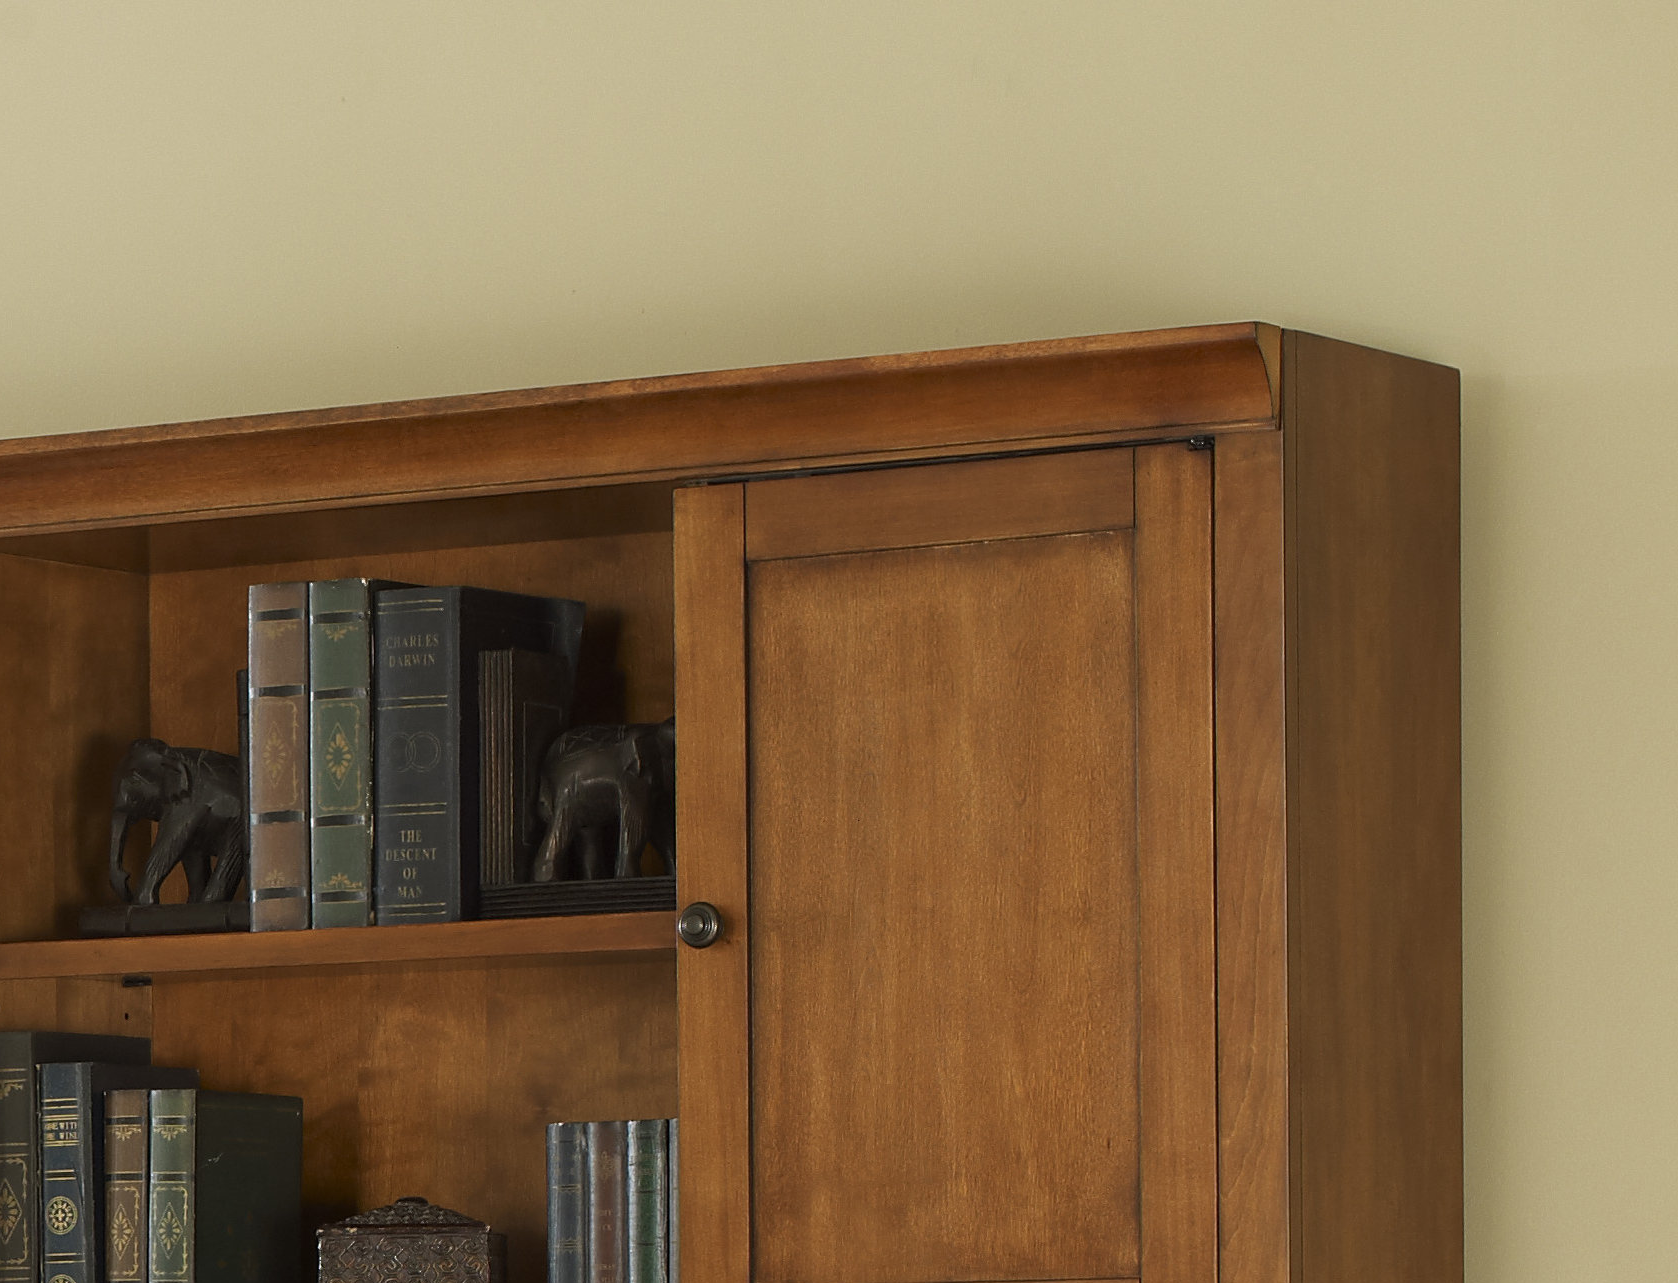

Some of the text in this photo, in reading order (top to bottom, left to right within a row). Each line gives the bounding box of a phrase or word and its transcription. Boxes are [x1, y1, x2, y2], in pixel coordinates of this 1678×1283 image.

[399, 830, 422, 842] THE
[385, 848, 437, 861] DESCENT
[403, 867, 417, 880] OF
